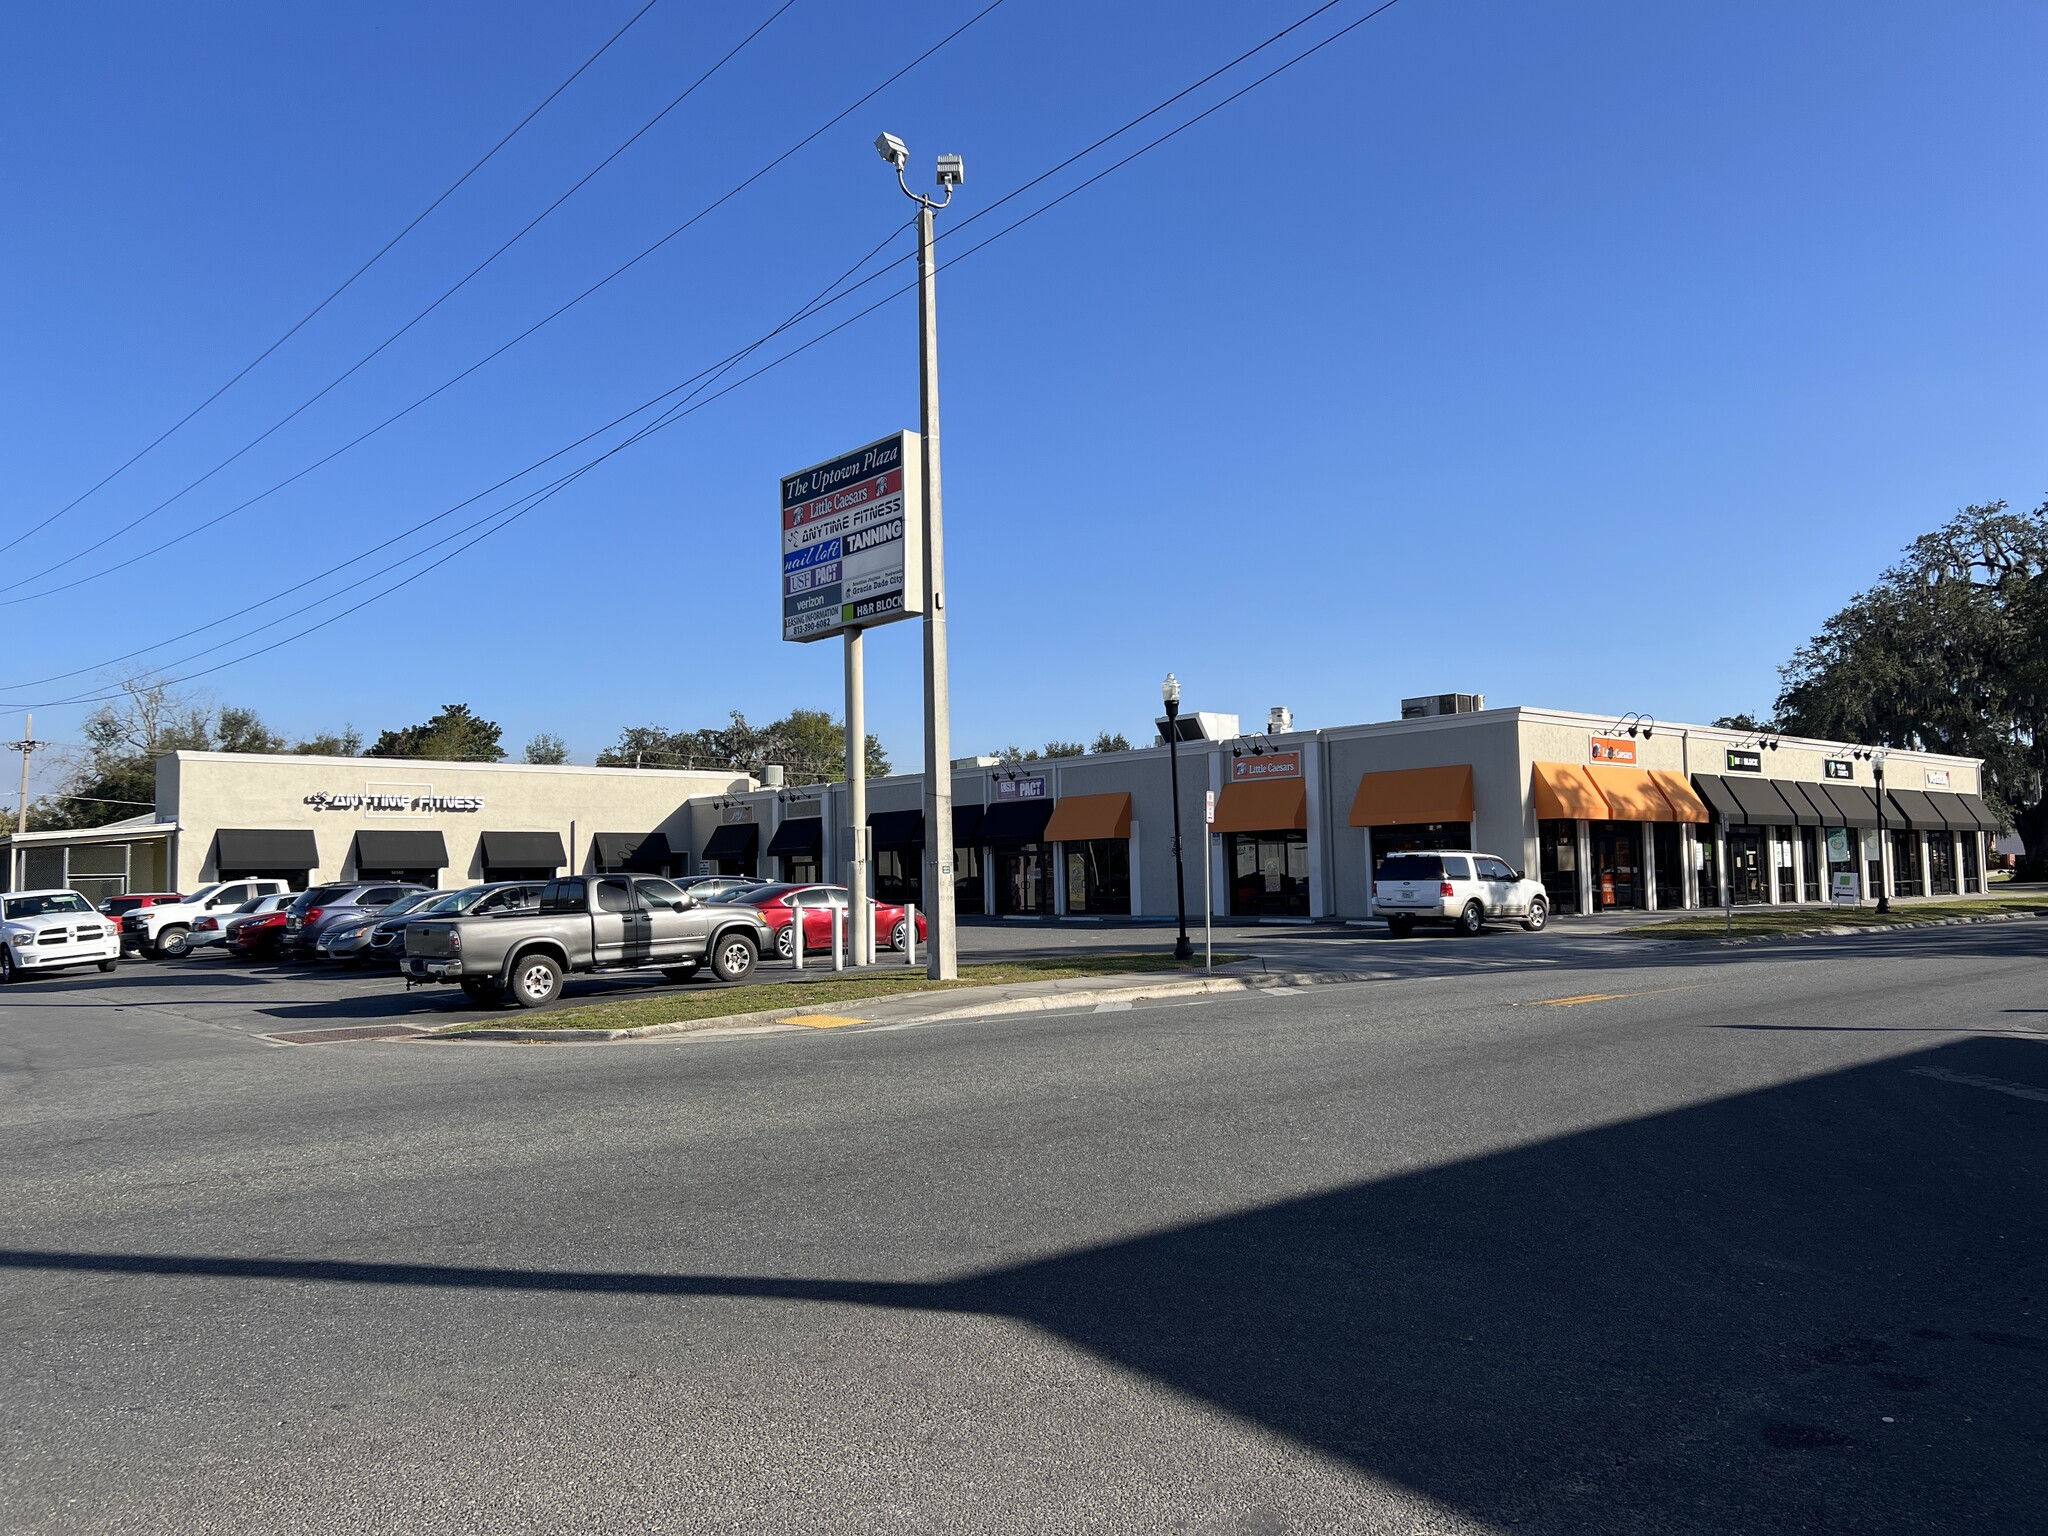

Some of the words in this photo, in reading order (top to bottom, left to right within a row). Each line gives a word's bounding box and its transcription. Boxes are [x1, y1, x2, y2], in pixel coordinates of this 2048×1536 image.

[787, 478, 808, 499] The
[812, 461, 860, 493] Uptown
[863, 446, 898, 472] Plaza
[810, 498, 832, 518] Little
[834, 487, 868, 510] Caesars
[802, 516, 849, 543] ANYTIME
[854, 498, 901, 526] FITNESS
[847, 519, 902, 553] TANNING
[785, 547, 814, 571] nail
[815, 541, 840, 561] loft
[793, 572, 810, 590] USF
[815, 563, 837, 586] PACT
[853, 583, 872, 595] Gracie
[874, 579, 888, 590] Dade
[890, 575, 902, 586] City
[797, 595, 825, 611] verizon
[857, 602, 875, 617] H&R
[876, 595, 903, 612] BLOCK
[786, 613, 805, 628] LEASING
[805, 606, 839, 624] INFORMATION
[794, 618, 831, 635] 813-390-6082
[1249, 764, 1266, 774] Little
[1268, 763, 1294, 773] Caesars
[1019, 781, 1041, 797] PACT
[333, 793, 411, 808] ANYTIME
[418, 795, 486, 810] FITNESS
